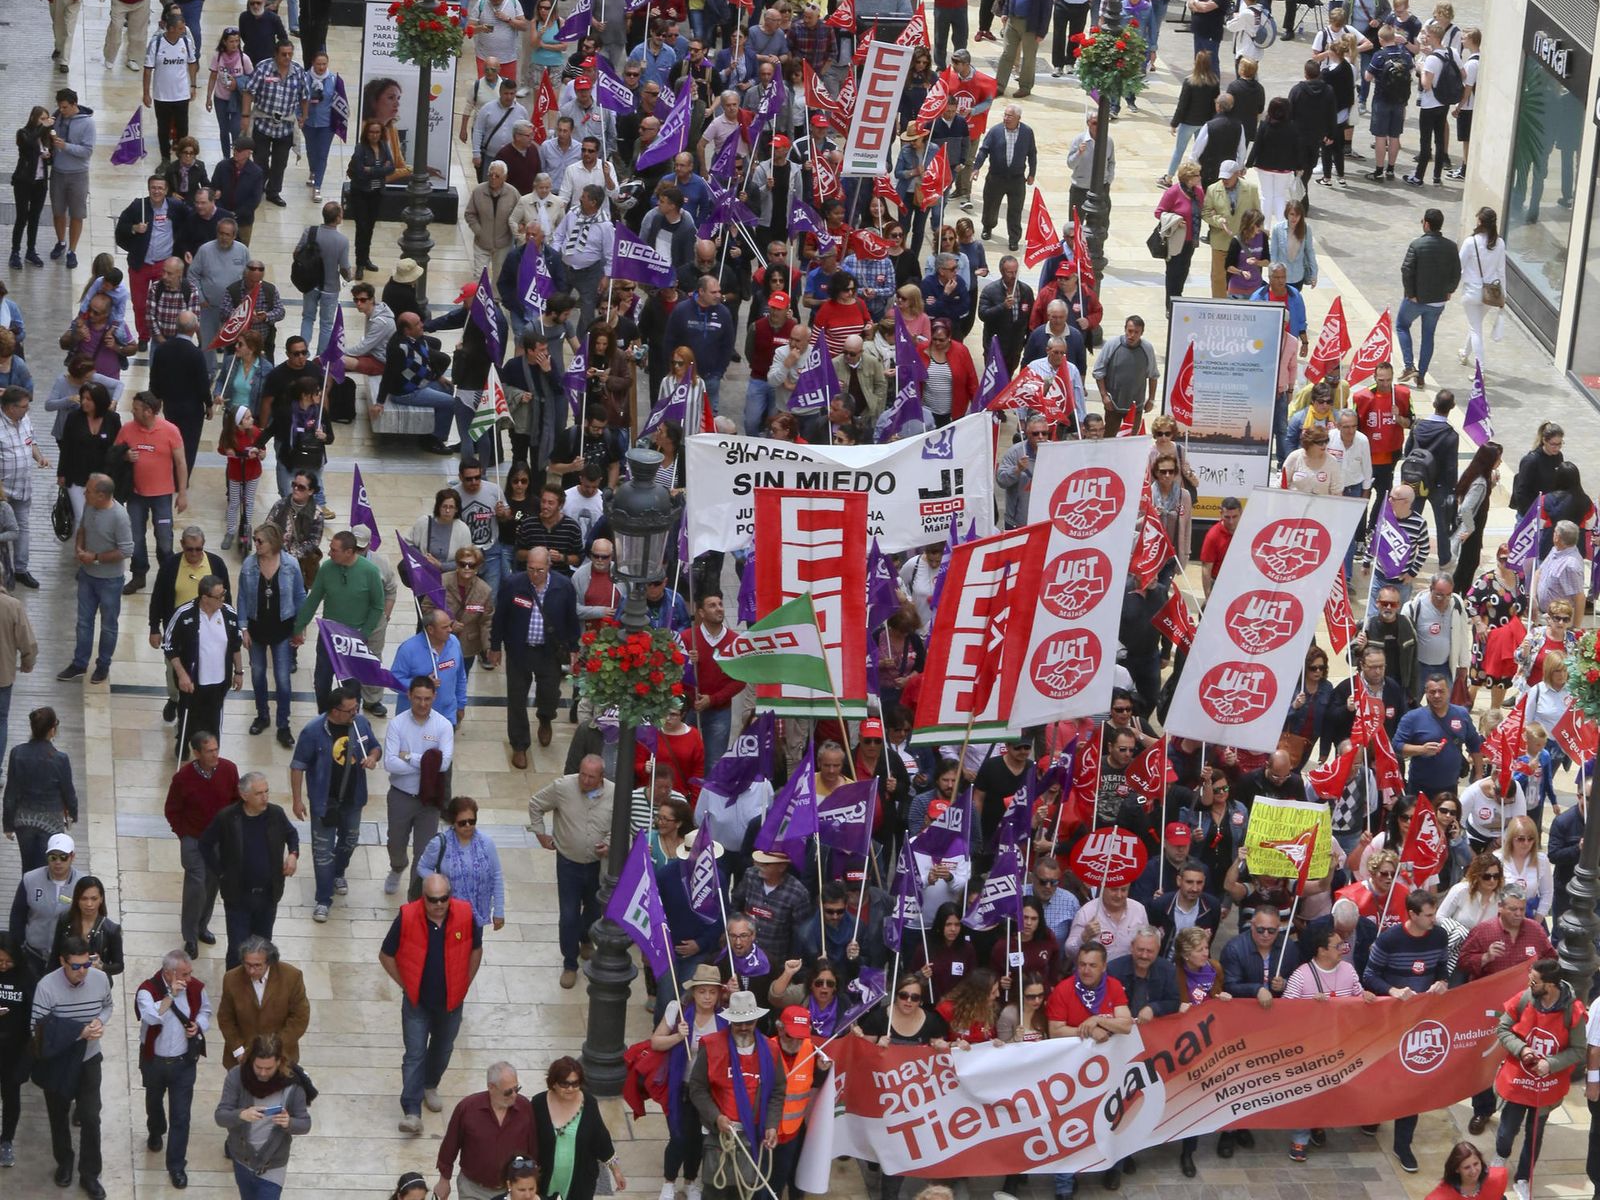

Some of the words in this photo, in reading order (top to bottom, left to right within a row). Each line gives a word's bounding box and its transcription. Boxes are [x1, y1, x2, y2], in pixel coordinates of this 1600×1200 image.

[162, 57, 184, 65] bwin
[1533, 31, 1573, 78] merkal
[601, 72, 634, 106] CCOO
[855, 47, 904, 150] CCOO
[733, 471, 784, 496] SIN
[796, 471, 896, 495] MIEDO
[1066, 476, 1111, 501] UGT
[923, 501, 961, 513] CCOO
[924, 519, 963, 533] Málaa
[1069, 527, 1098, 537] Málaga
[1271, 525, 1319, 549] UGT
[1056, 556, 1099, 582] UGT
[1267, 570, 1297, 581] Málaga
[1059, 608, 1088, 618] Málaga
[1244, 596, 1292, 621] UGT
[1046, 636, 1088, 664] UGT
[1240, 642, 1270, 652] Málaga
[1049, 688, 1078, 698] Málaga
[1218, 668, 1265, 692] UGT
[1215, 714, 1244, 724] Málaga
[1083, 833, 1138, 859] UGT
[36, 889, 43, 901] P
[1407, 1027, 1442, 1053] UGT
[872, 1053, 955, 1091] mayo
[1104, 1013, 1215, 1132] ganar
[1187, 1038, 1247, 1081] Igualdad
[1201, 1062, 1240, 1092] Mejor
[1246, 1044, 1304, 1070] empleo
[1215, 1071, 1281, 1103] Mayores
[1285, 1049, 1345, 1078] salarios
[1231, 1082, 1312, 1115] Pensiones
[1316, 1057, 1364, 1089] dignas
[879, 1070, 960, 1120] 2018
[886, 1054, 1109, 1161] Tiempo
[1023, 1117, 1089, 1161] de
